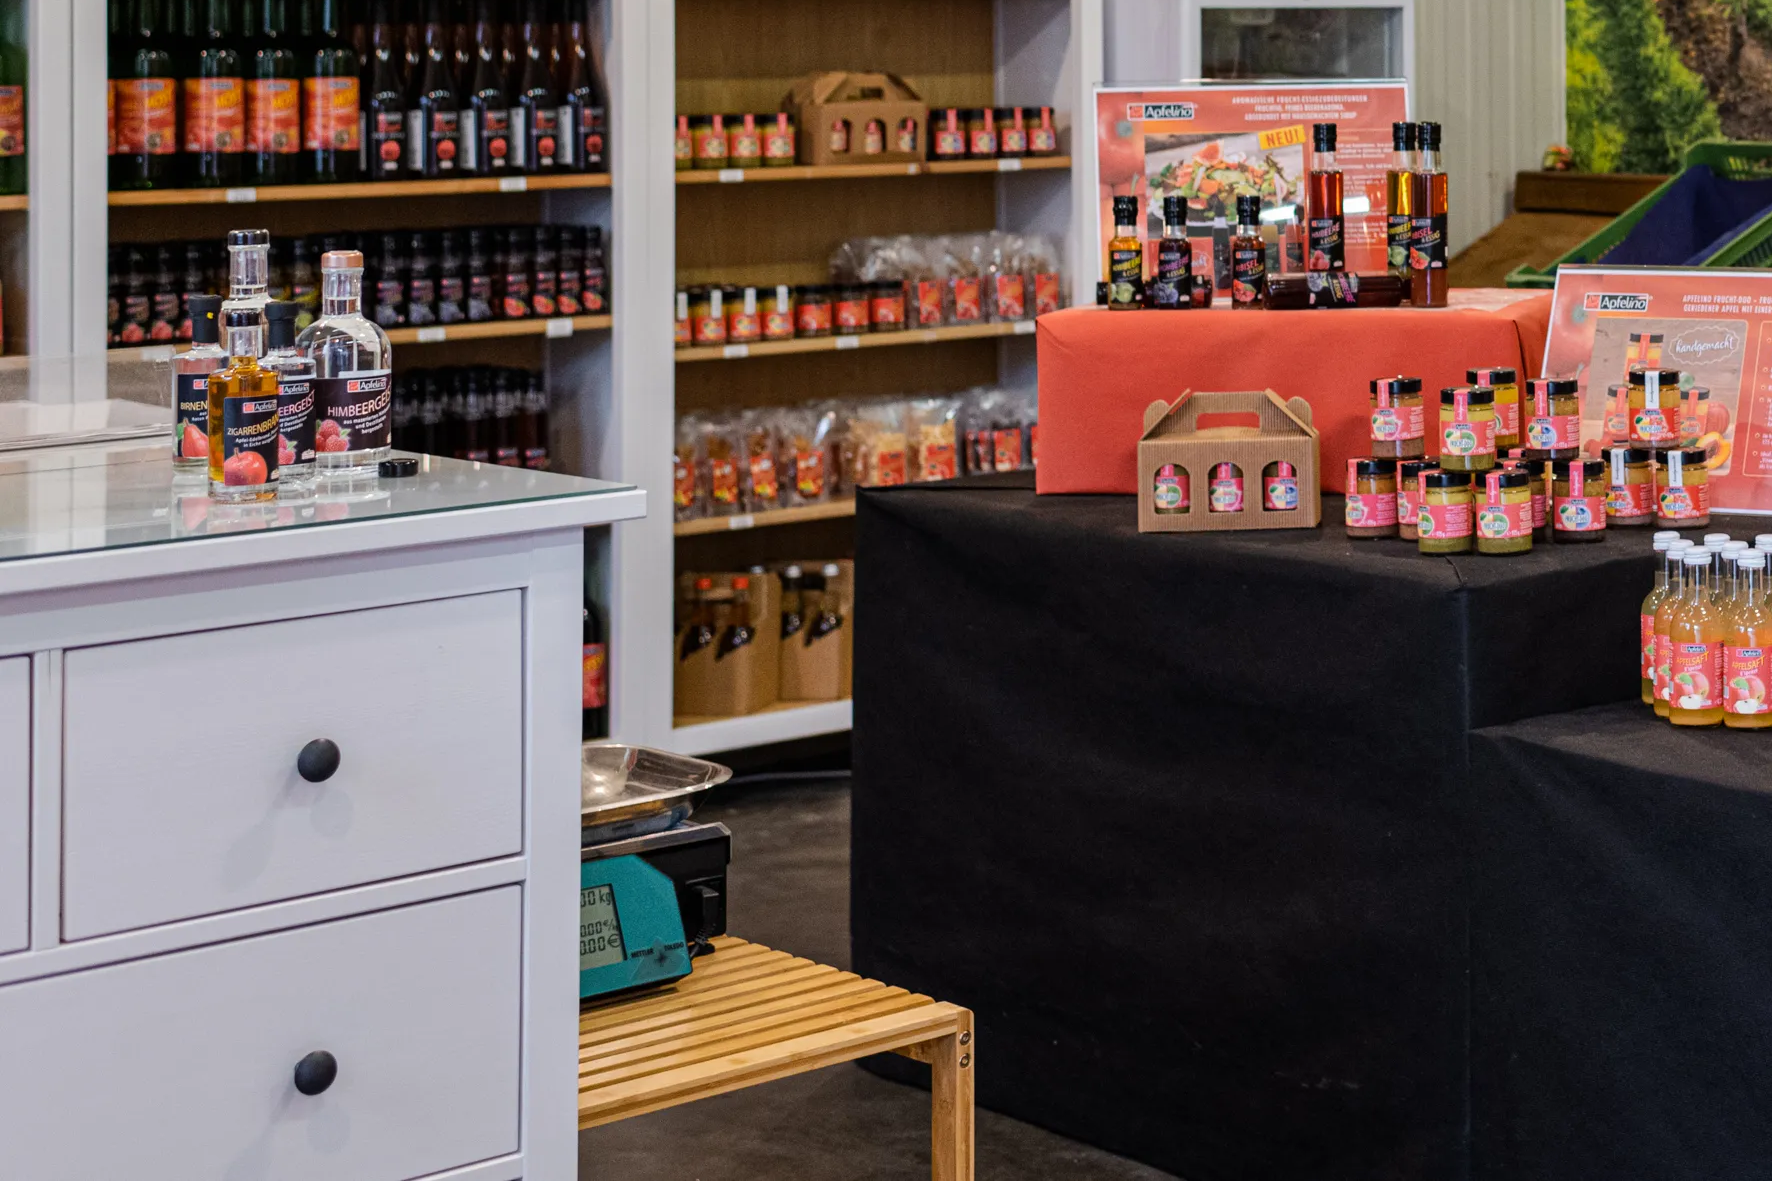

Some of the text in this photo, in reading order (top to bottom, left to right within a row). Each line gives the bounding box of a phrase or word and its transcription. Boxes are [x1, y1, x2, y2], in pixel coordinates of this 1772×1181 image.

[1145, 105, 1192, 119] Apfelino
[1266, 128, 1299, 148] NEU!
[1600, 295, 1647, 311] Apfelino
[1682, 295, 1712, 303] APFELINO
[1721, 305, 1740, 313] APFEL
[1676, 334, 1734, 357] handgemacht
[284, 384, 309, 395] Apfelino
[360, 379, 386, 391] Apfelino
[180, 401, 208, 411] BIRNEN
[254, 401, 277, 411] Apfelino
[278, 389, 315, 417] EERGEIST
[227, 411, 279, 435] ZIGARRENBRAN
[1676, 651, 1709, 666] APFELSAFT
[1732, 655, 1764, 671] APFELSAFT
[599, 889, 610, 905] kg
[631, 948, 654, 959] METTLER
